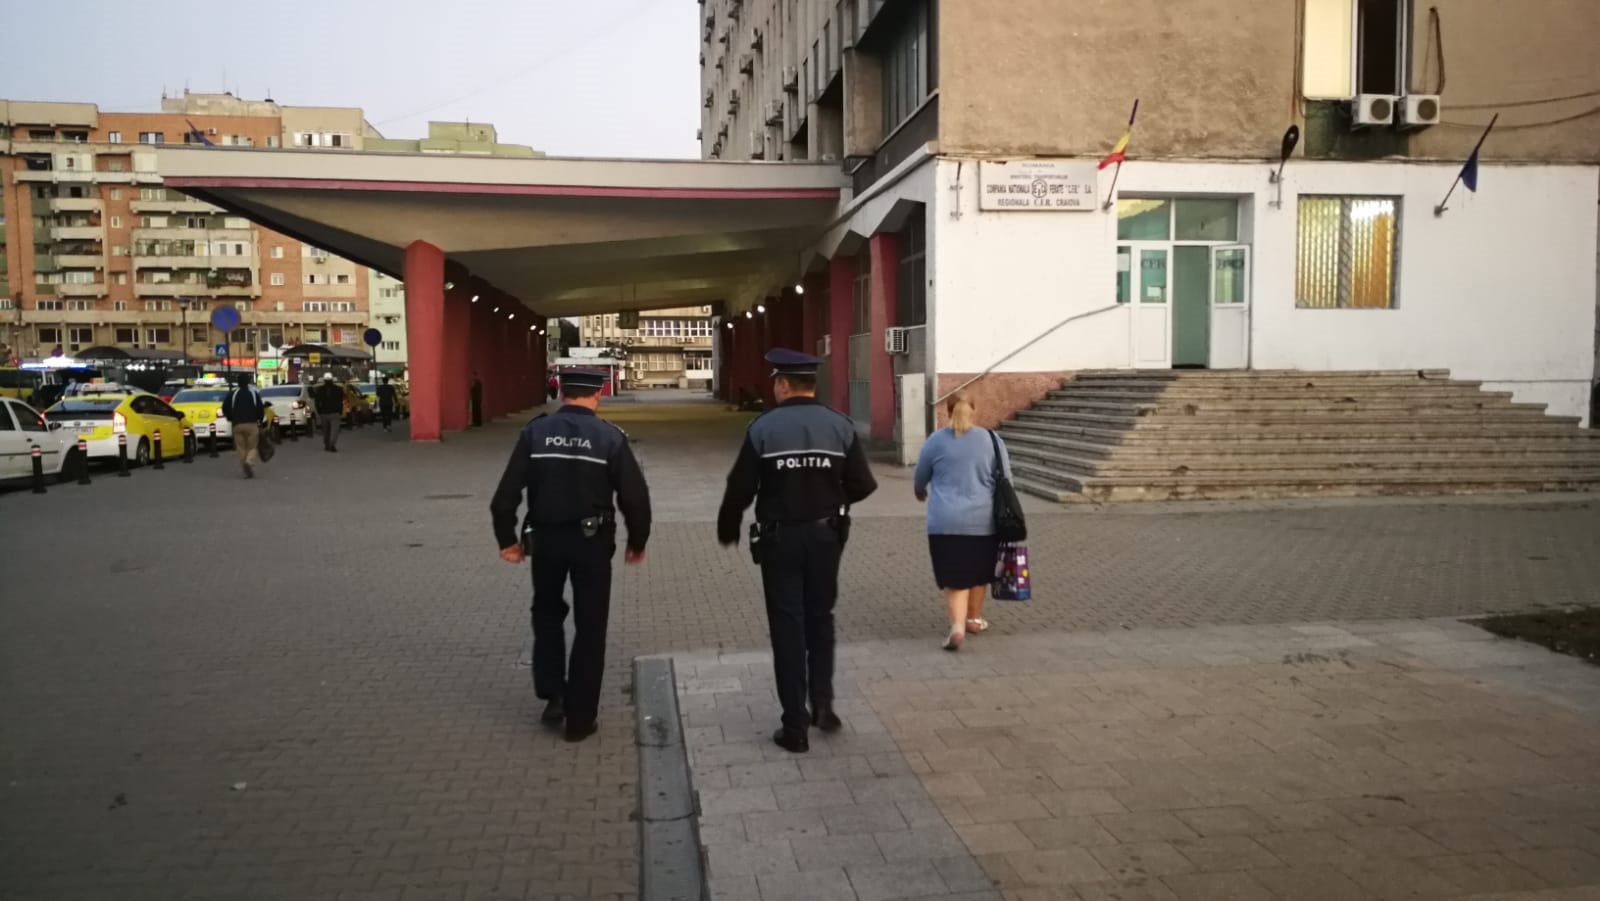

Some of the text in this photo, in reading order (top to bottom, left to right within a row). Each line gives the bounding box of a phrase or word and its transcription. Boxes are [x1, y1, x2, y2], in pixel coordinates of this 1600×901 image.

[997, 198, 1030, 207] REGIONALA
[1056, 198, 1080, 207] CRAIOVA
[776, 456, 832, 470] POLITIA
